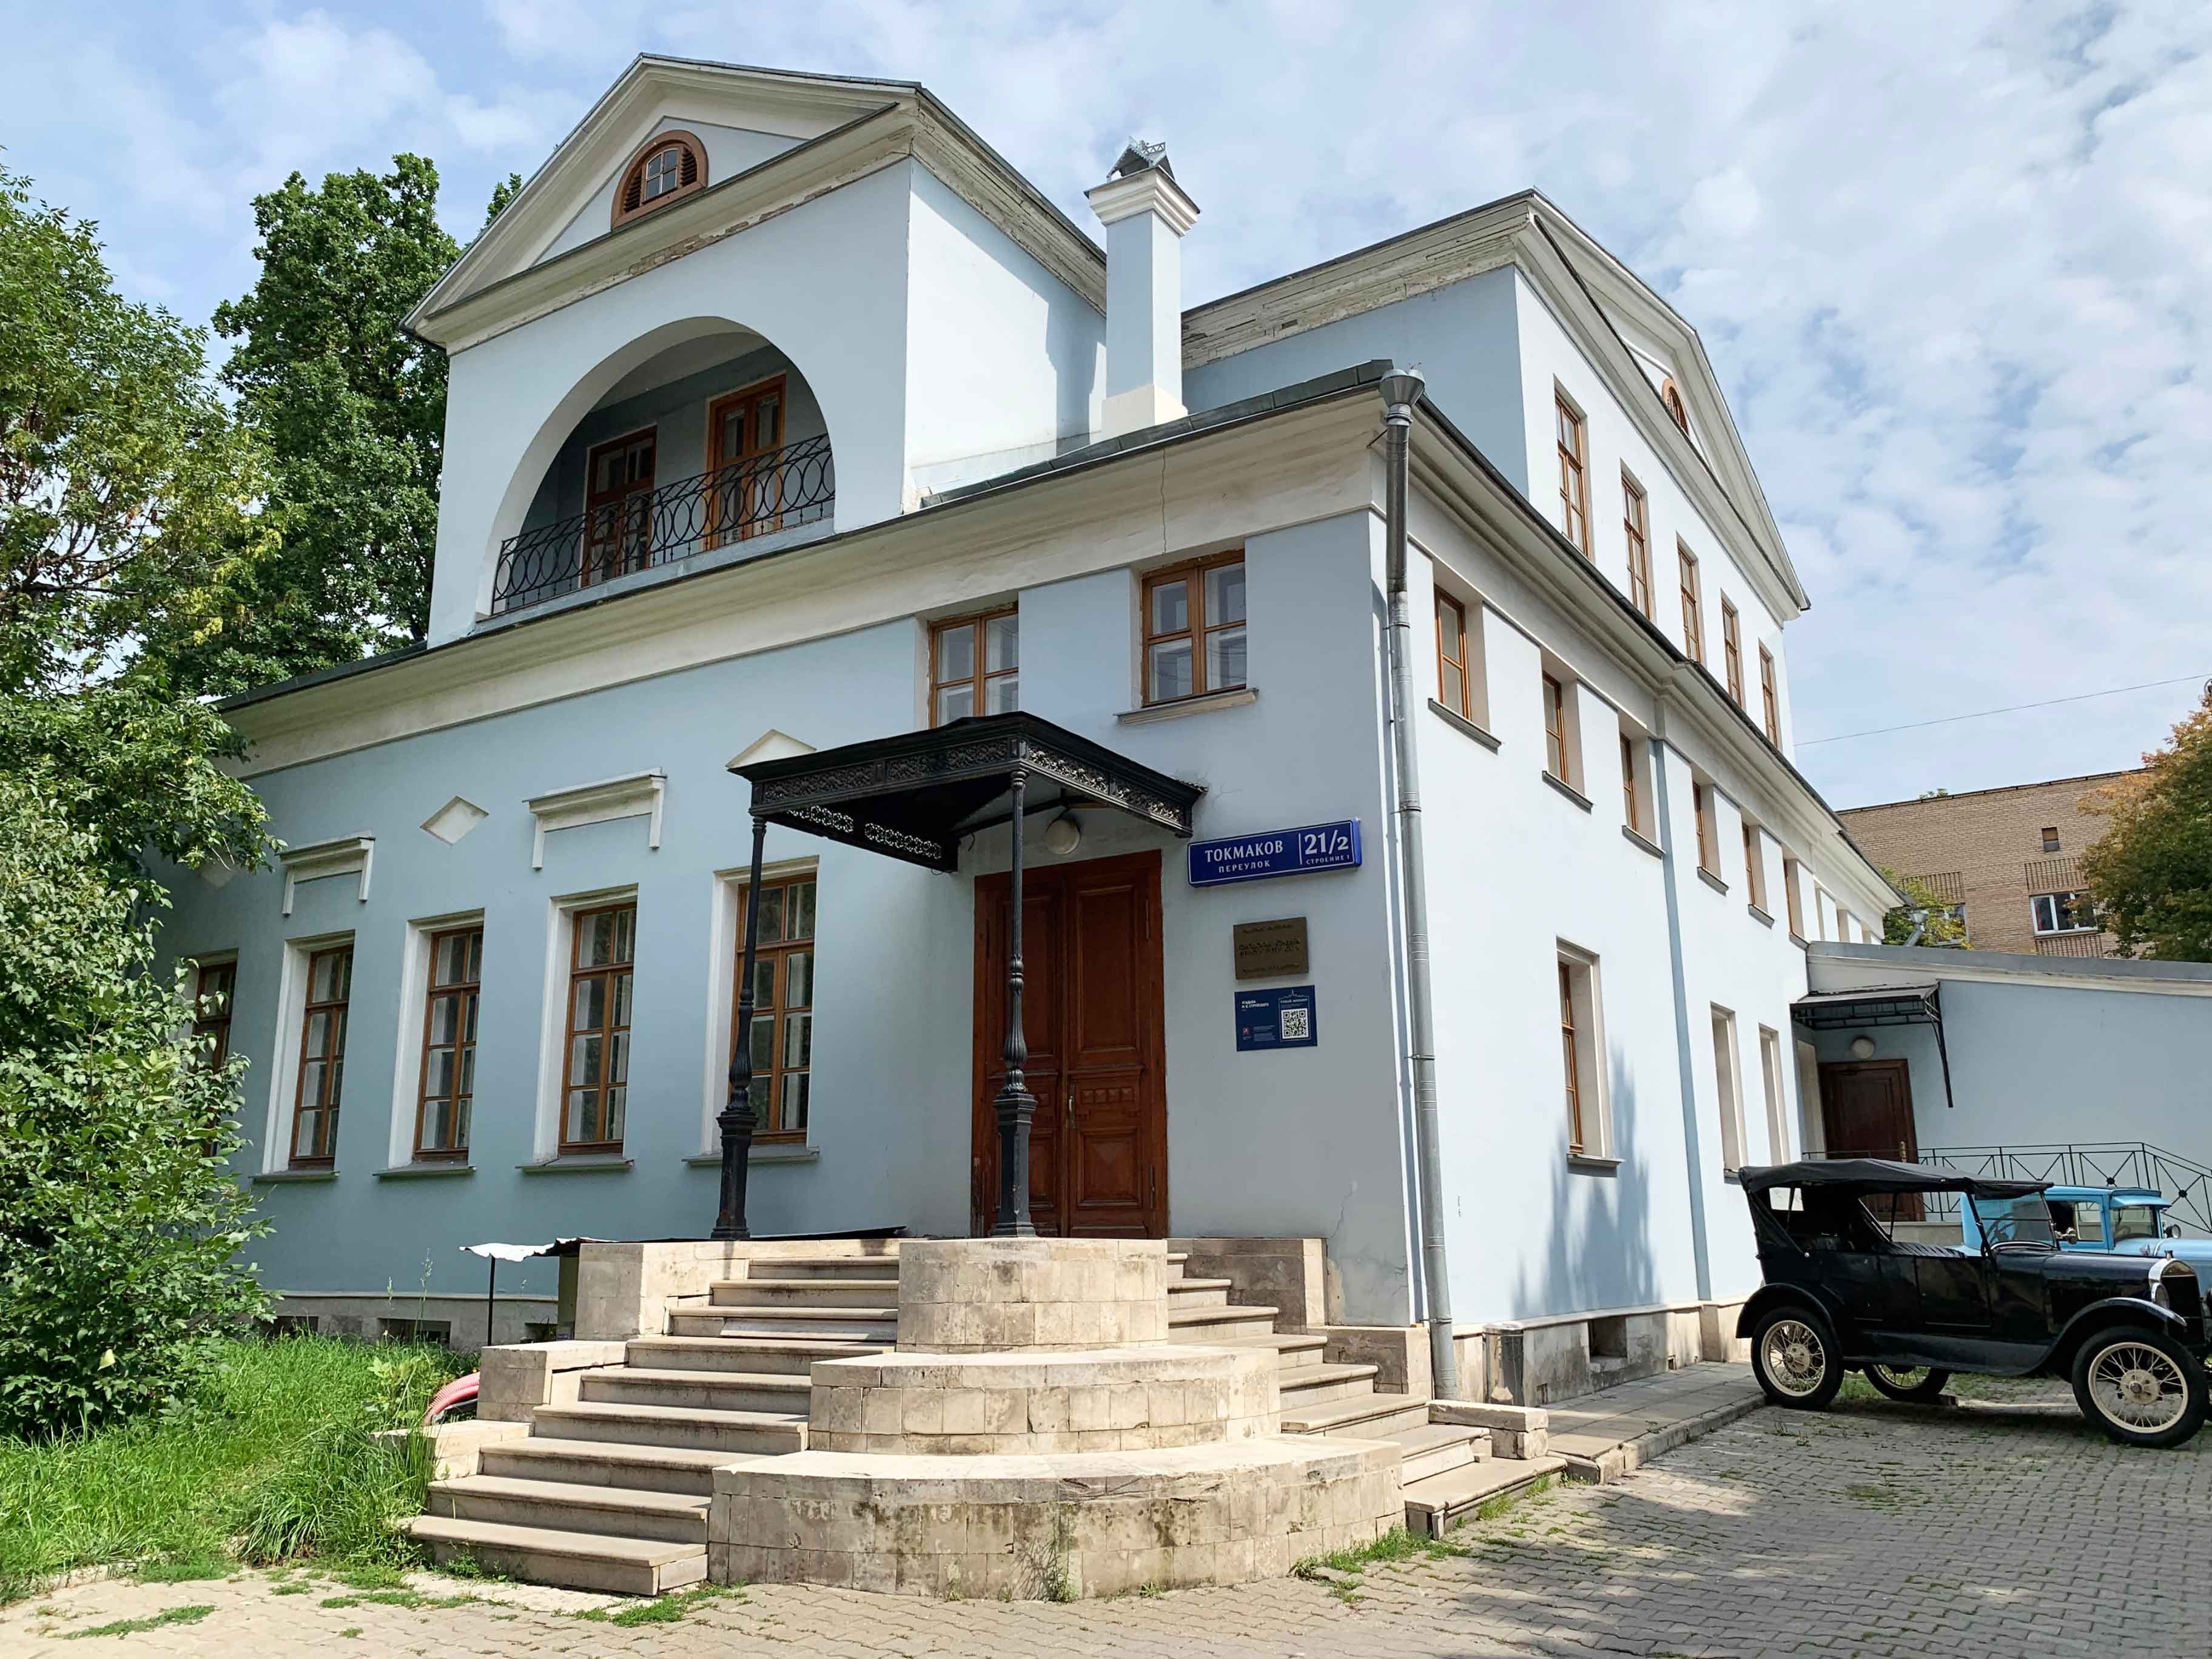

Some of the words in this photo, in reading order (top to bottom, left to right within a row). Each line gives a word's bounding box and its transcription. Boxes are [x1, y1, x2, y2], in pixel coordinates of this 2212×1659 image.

[1305, 830, 1349, 854] 21/2
[1205, 841, 1283, 863] ТОКМАКОВ
[1306, 855, 1344, 864] СТРОЕНИЕ
[1219, 860, 1271, 873] ПЕРЕУЛОК
